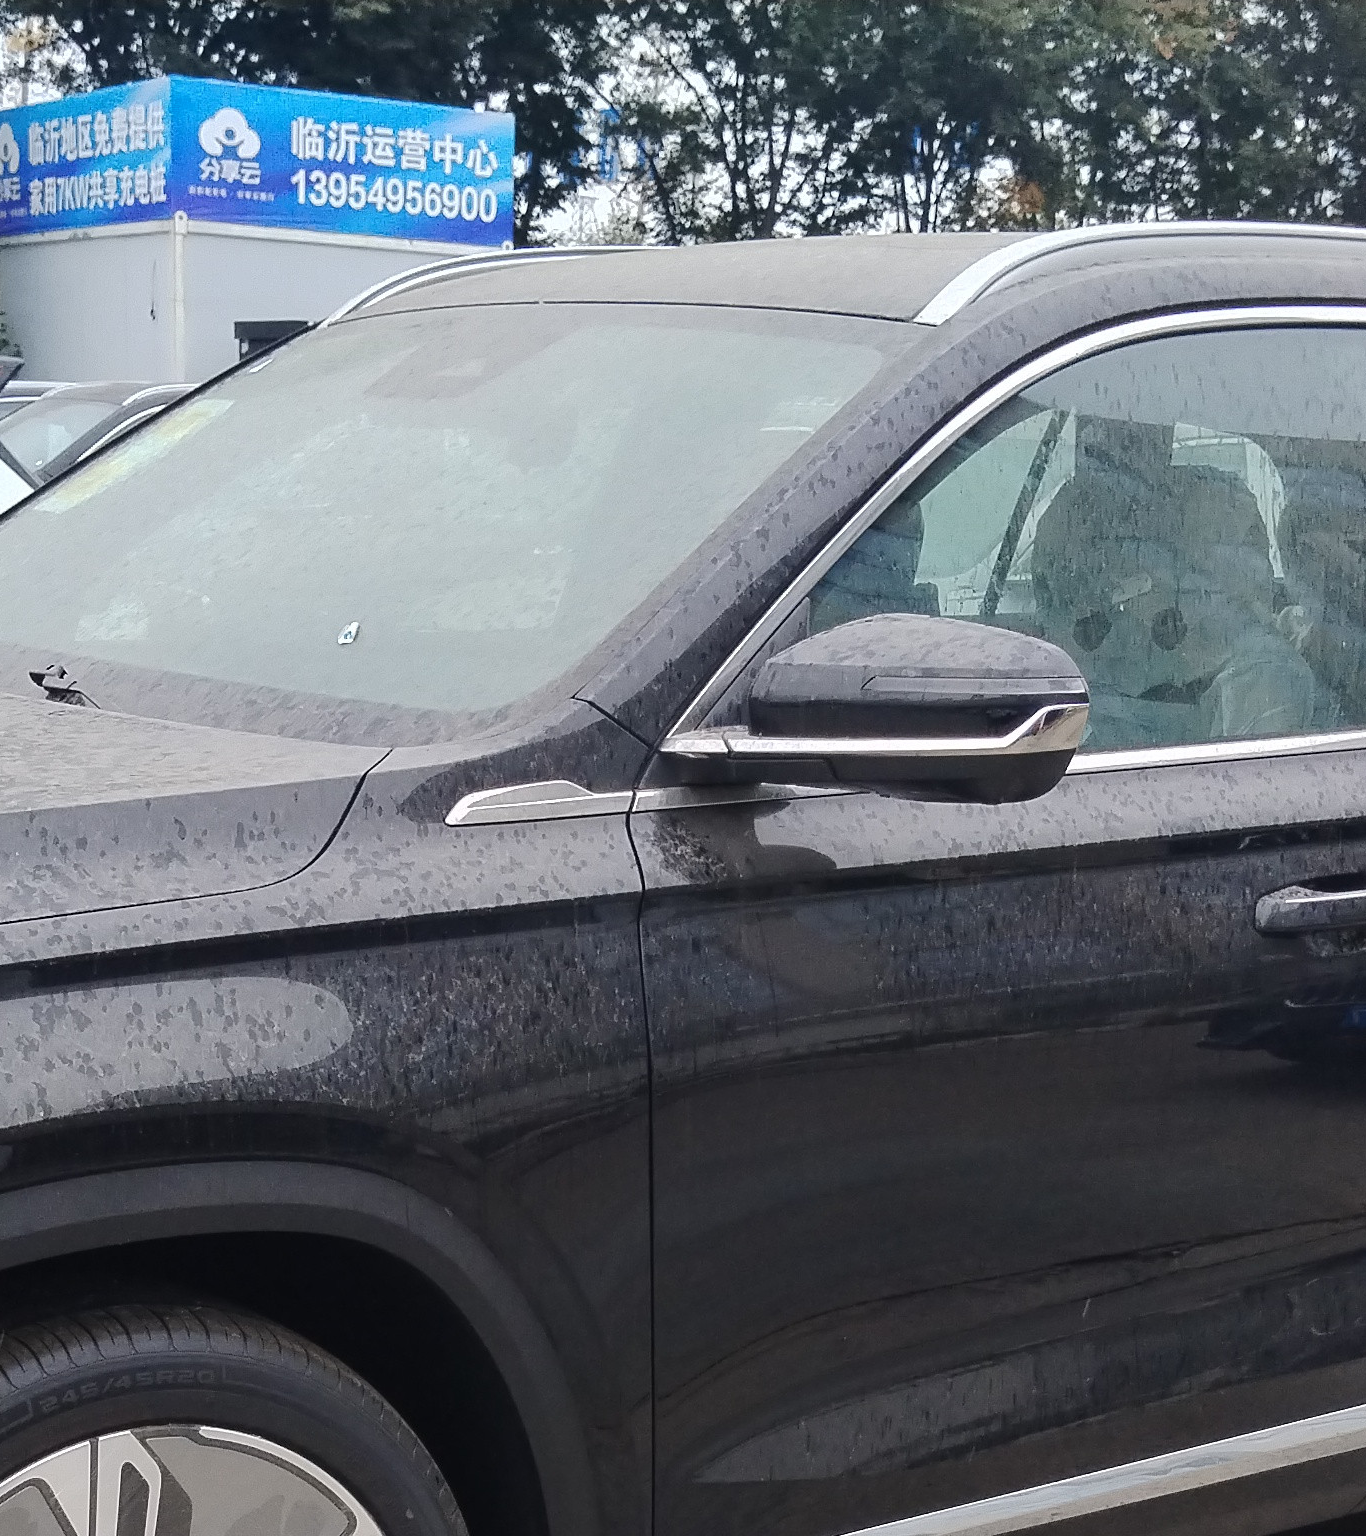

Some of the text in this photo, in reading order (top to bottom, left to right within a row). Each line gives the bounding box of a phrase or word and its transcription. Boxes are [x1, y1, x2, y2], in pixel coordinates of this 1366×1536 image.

[28, 100, 165, 166] 临沂地区免费提供
[291, 116, 499, 178] 临沂运营中心
[28, 160, 167, 216] 家用7KW共享充电桩
[198, 156, 262, 185] 分享云
[291, 168, 499, 224] 13954956900
[38, 1369, 217, 1414] 245/45R20
